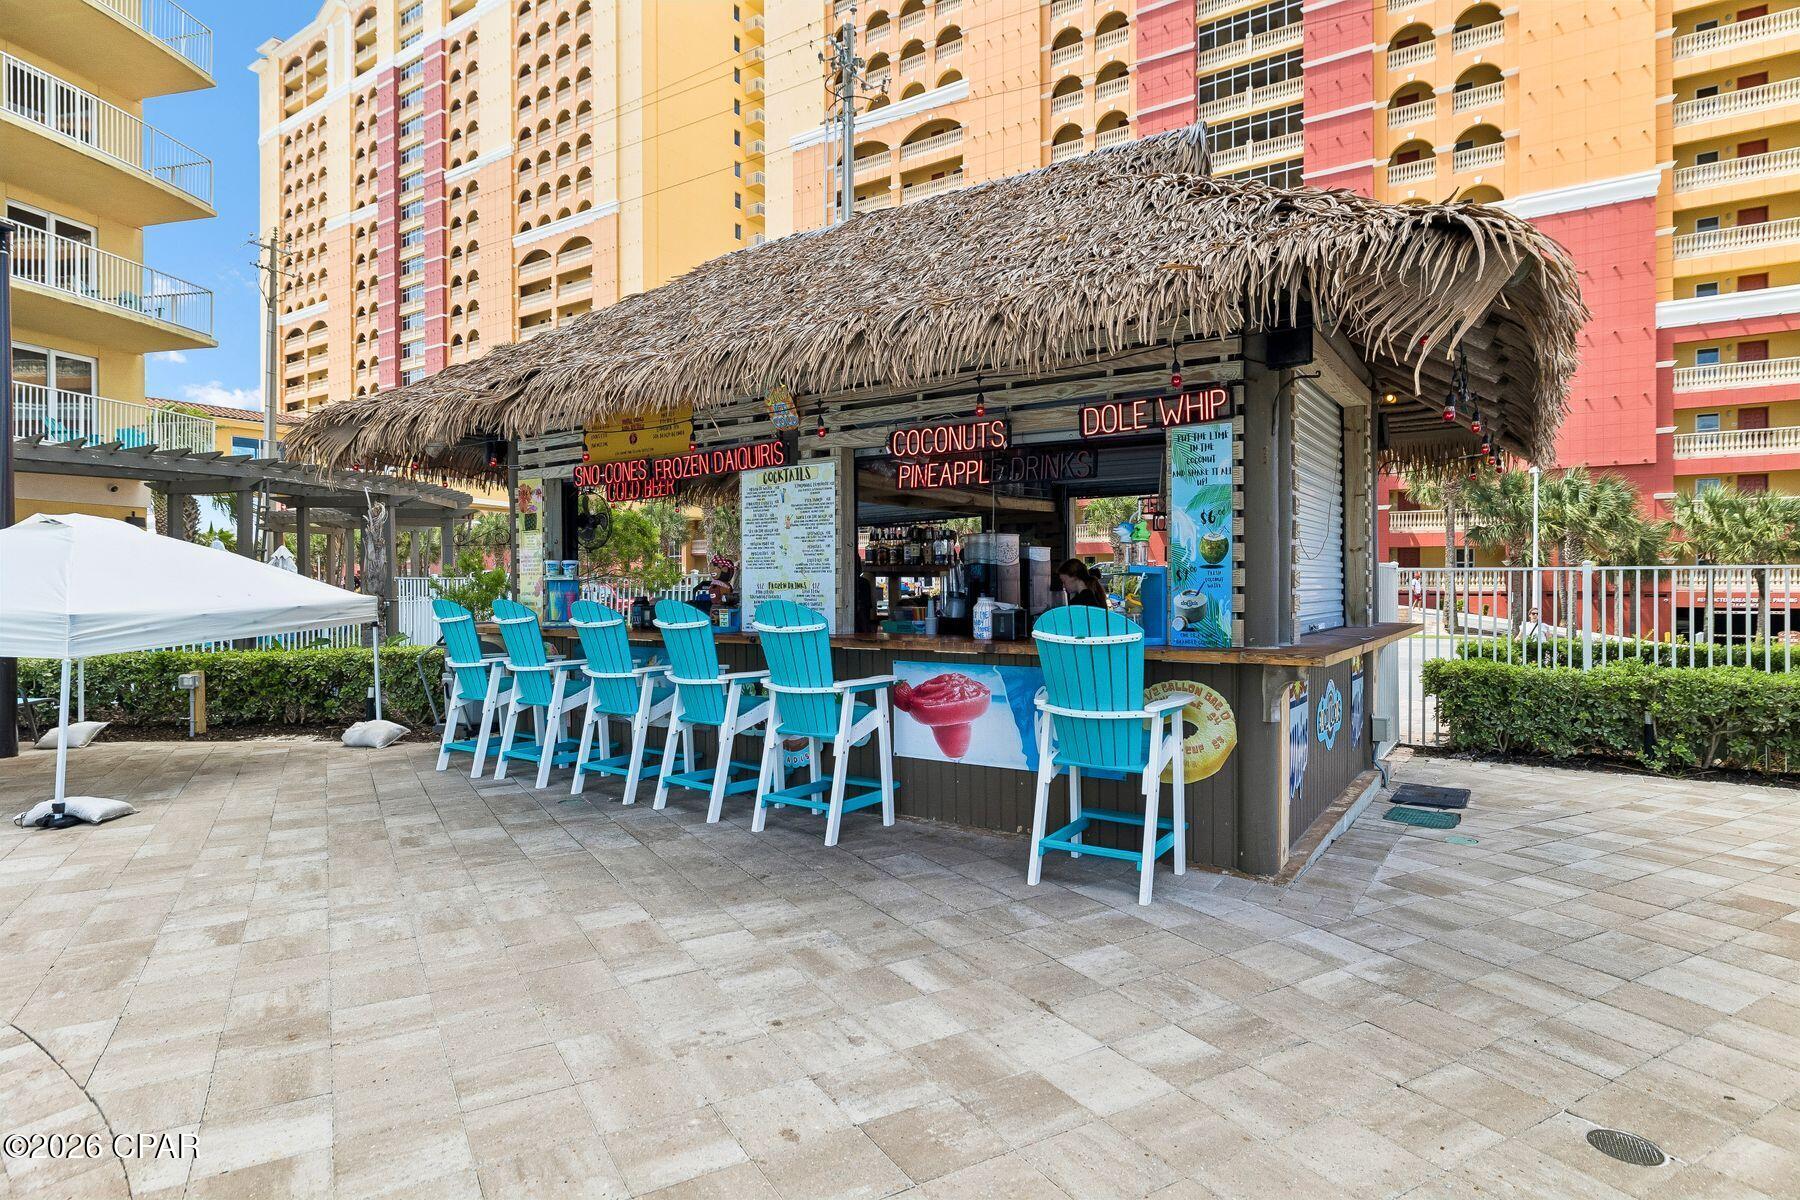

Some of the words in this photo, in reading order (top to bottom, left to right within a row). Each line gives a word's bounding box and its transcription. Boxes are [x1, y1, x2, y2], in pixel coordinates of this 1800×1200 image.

[1083, 400, 1148, 436] DOLE
[1158, 389, 1226, 426] WHIP
[892, 420, 1005, 457] COCONUTS
[1177, 432, 1191, 443] PUT
[1193, 431, 1207, 441] THE
[1209, 429, 1229, 440] LIME
[1189, 444, 1198, 452] IN
[1200, 442, 1214, 452] THE
[574, 459, 647, 487] SNO-CONES
[654, 453, 710, 480] FROZEN
[713, 441, 784, 474] DAIQUIRIS
[898, 458, 1003, 489] PINEAPPLE
[1011, 450, 1092, 482] DRINKS
[1186, 454, 1216, 465] COCONUT
[763, 466, 811, 485] COCKTAILS
[1172, 469, 1185, 478] AND
[1188, 468, 1209, 476] SHAKE
[1212, 467, 1220, 476] IT
[1221, 466, 1232, 476] ALL
[607, 480, 640, 502] COLD
[644, 478, 675, 499] BEER
